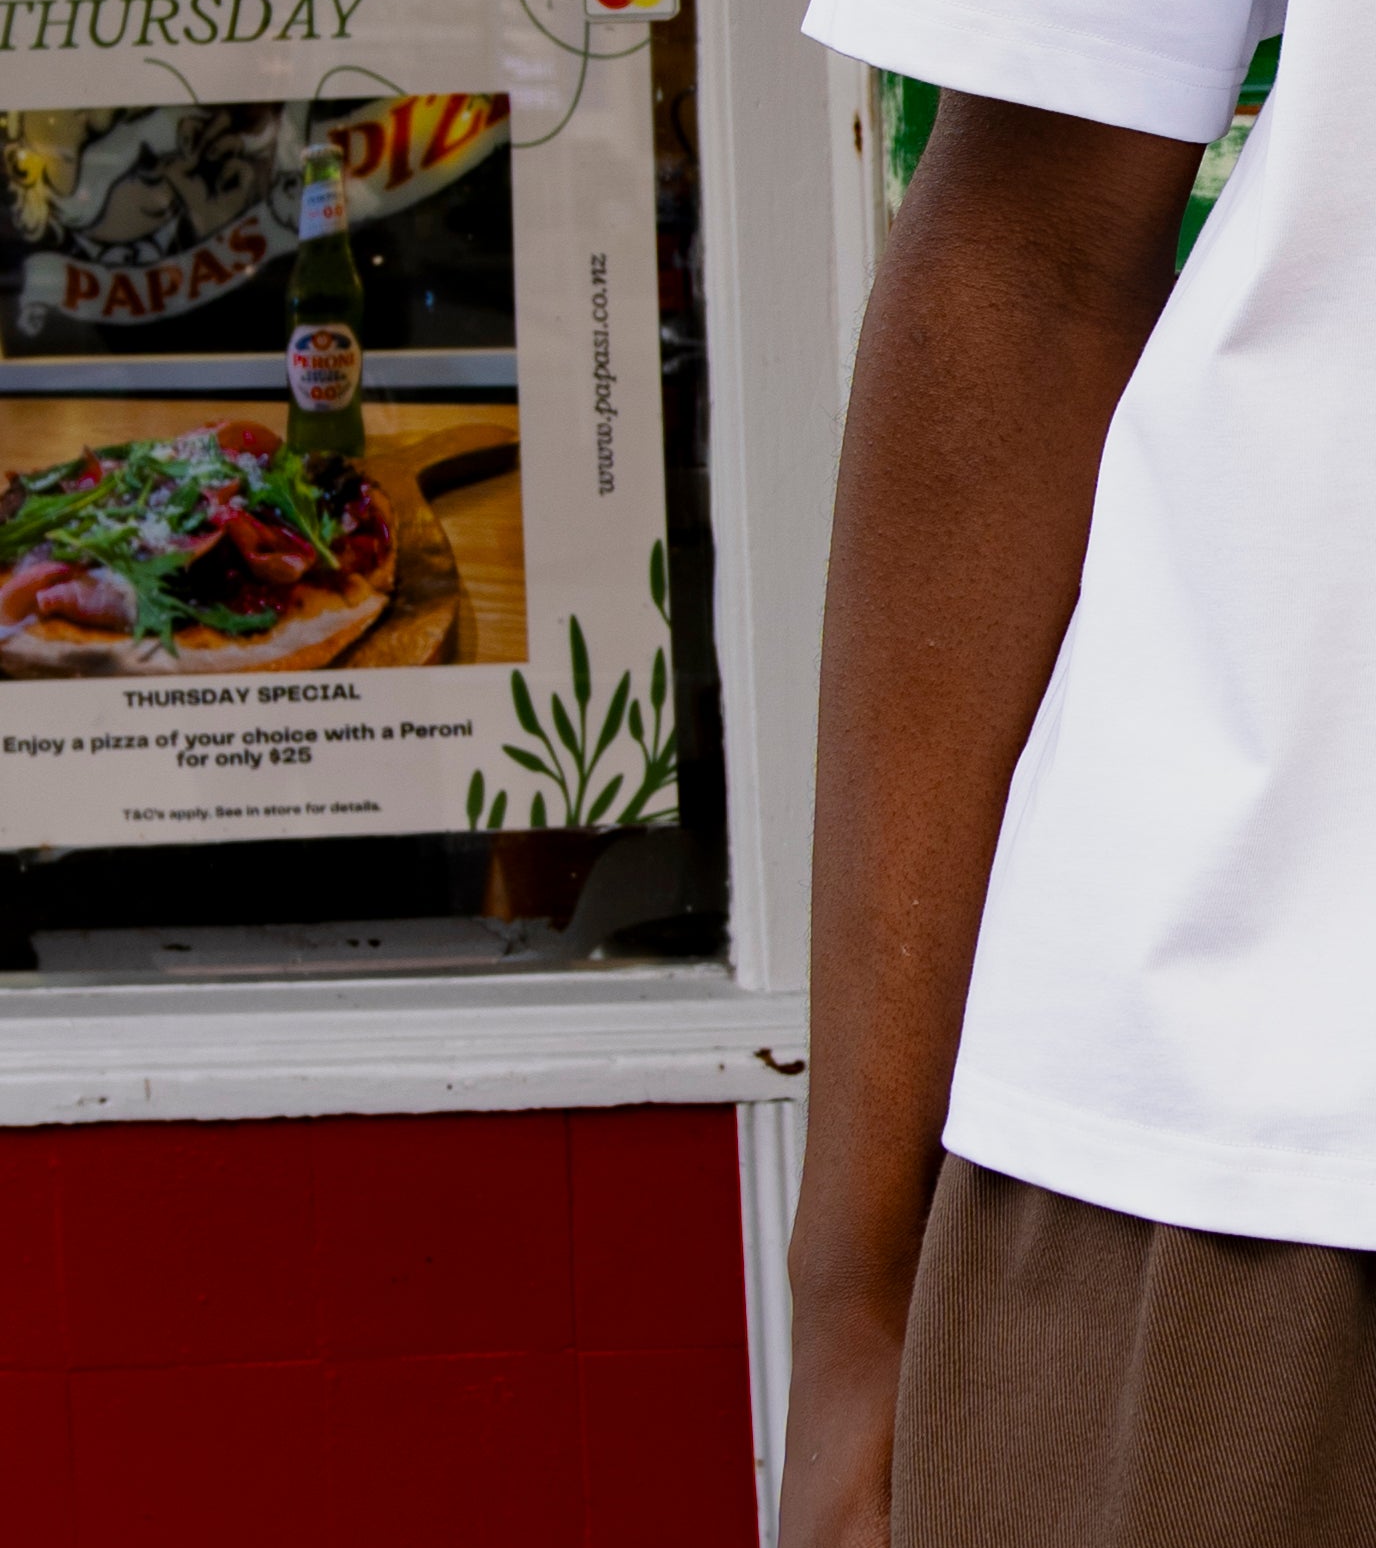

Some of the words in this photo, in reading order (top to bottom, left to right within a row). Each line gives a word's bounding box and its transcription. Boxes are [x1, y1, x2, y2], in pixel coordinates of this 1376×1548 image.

[63, 217, 268, 316] PAPA'S
[591, 252, 618, 497] www.papasi.co.nz
[124, 688, 250, 708] THURSDAY
[258, 684, 361, 704] SPECIAL
[3, 736, 64, 758] Enjoy
[72, 738, 86, 752] a
[91, 732, 149, 755] pizza
[156, 730, 180, 749] of
[184, 733, 235, 754] your
[242, 726, 317, 746] choice
[324, 723, 375, 743] with
[381, 727, 395, 741] a
[400, 720, 474, 741] Peroni
[177, 751, 209, 768] for
[215, 749, 262, 771] only
[269, 747, 312, 765] $25
[215, 806, 242, 818] See
[263, 804, 301, 817] store
[305, 802, 326, 815] for
